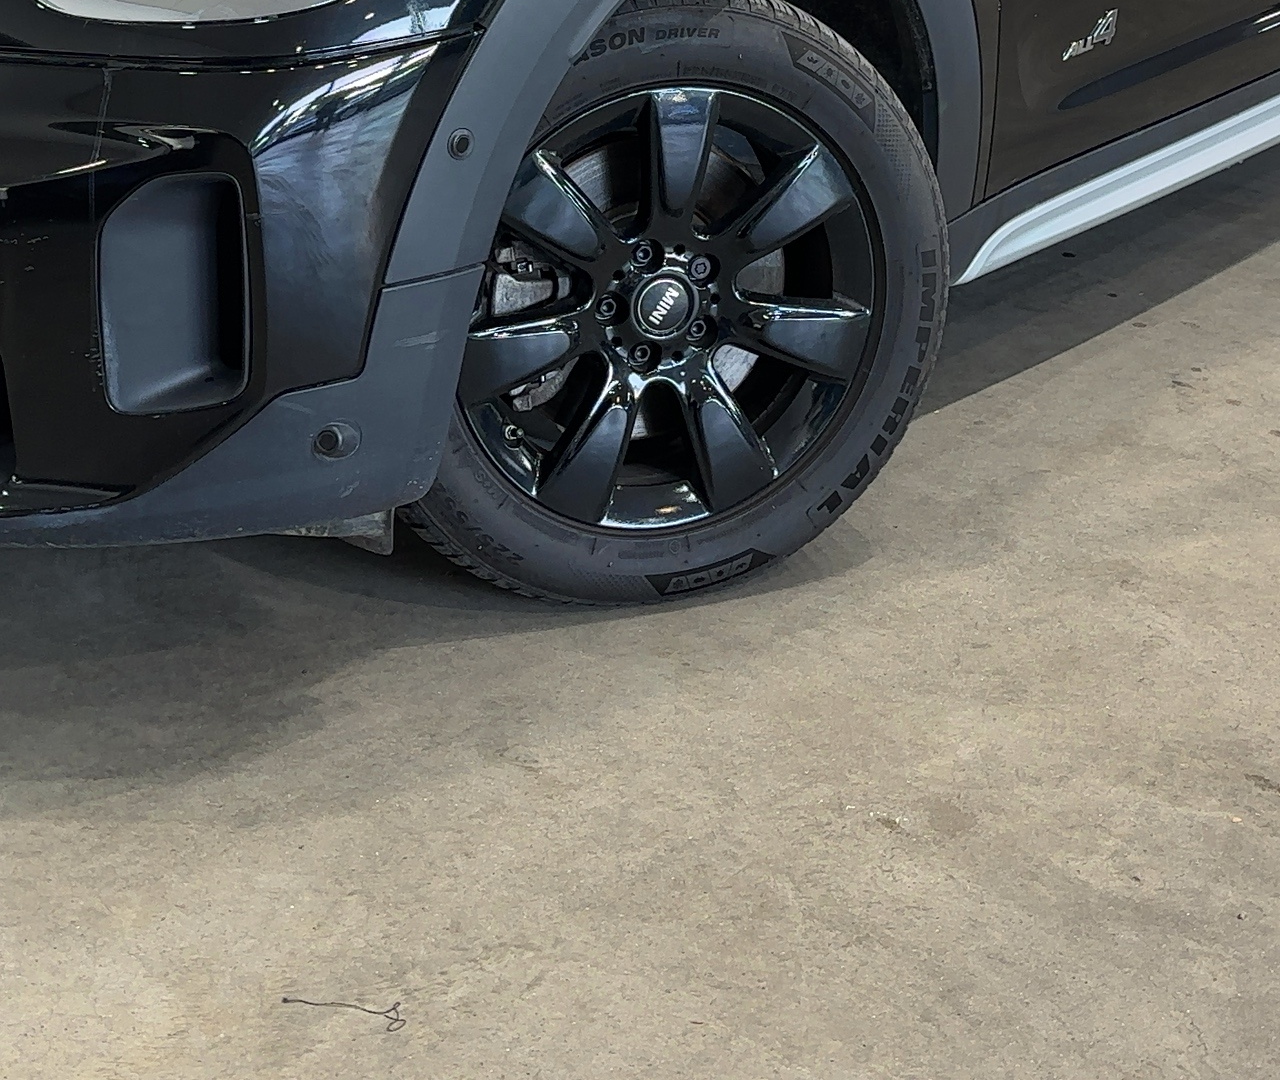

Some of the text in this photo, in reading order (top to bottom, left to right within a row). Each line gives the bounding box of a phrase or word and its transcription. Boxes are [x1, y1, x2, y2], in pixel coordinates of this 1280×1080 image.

[655, 27, 720, 40] DRIVER
[648, 286, 680, 326] MINI
[816, 248, 937, 515] IMPERIAL
